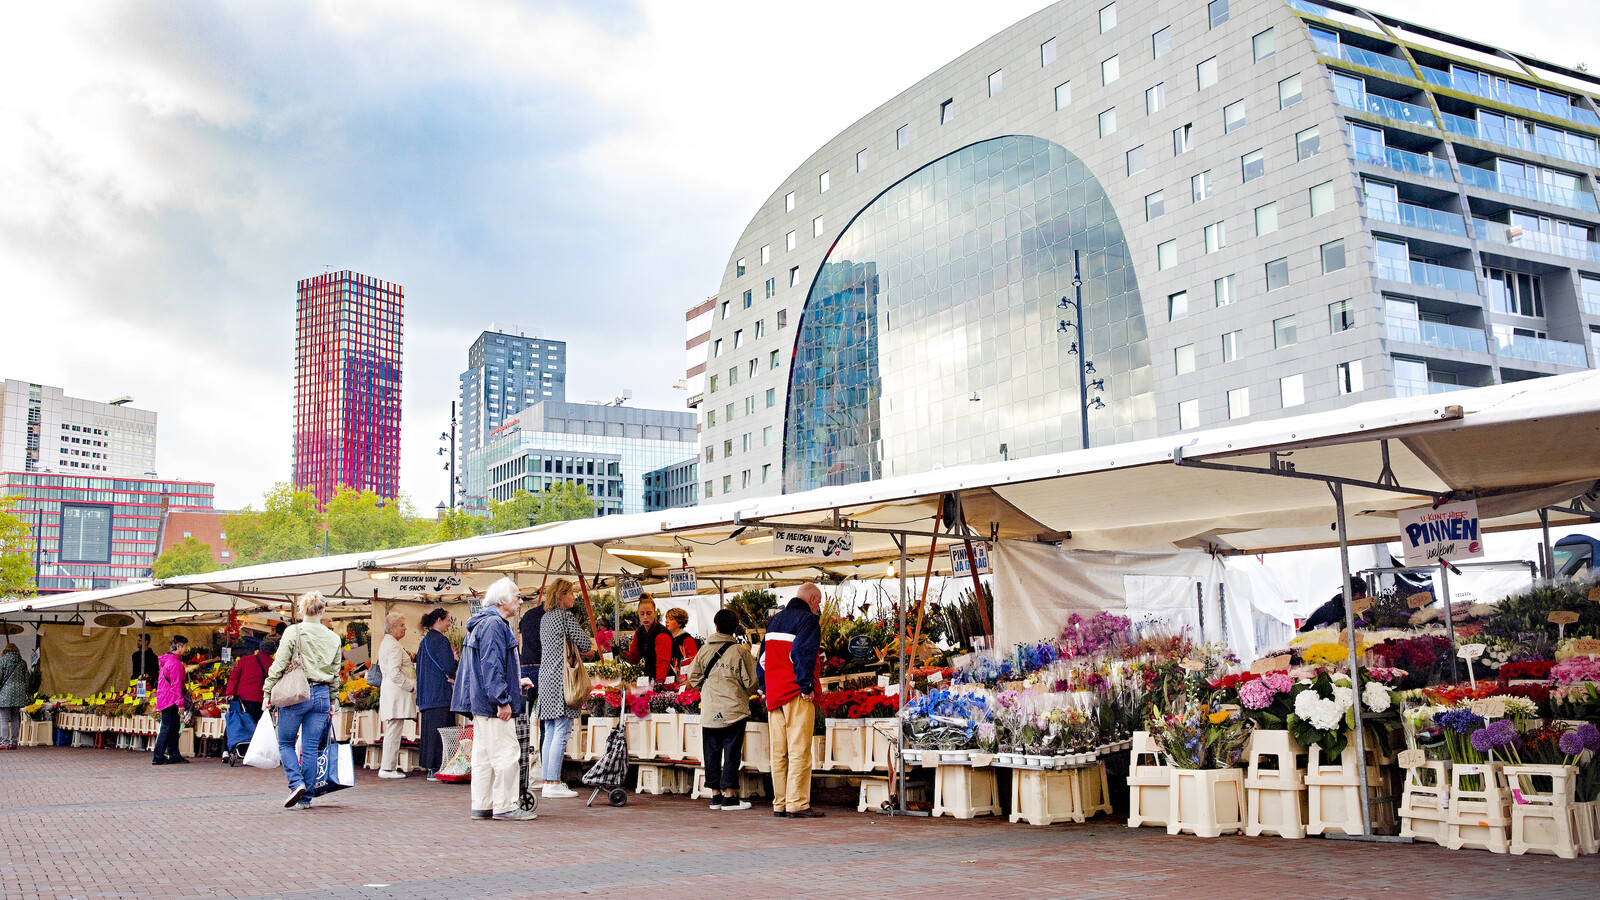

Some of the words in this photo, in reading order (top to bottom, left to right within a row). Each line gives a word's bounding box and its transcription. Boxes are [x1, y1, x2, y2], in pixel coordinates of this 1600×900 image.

[1427, 512, 1447, 521] KUNT
[1448, 510, 1468, 519] HIER
[776, 531, 785, 540] DE
[786, 532, 813, 543] MEIDEN
[813, 535, 827, 544] VAN
[1405, 517, 1477, 548] PINNEN
[785, 544, 794, 553] DE
[795, 545, 815, 554] SNOR
[955, 561, 964, 572] JA
[964, 557, 987, 571] GAAG
[672, 583, 679, 592] JA
[680, 581, 696, 591] GRAAG
